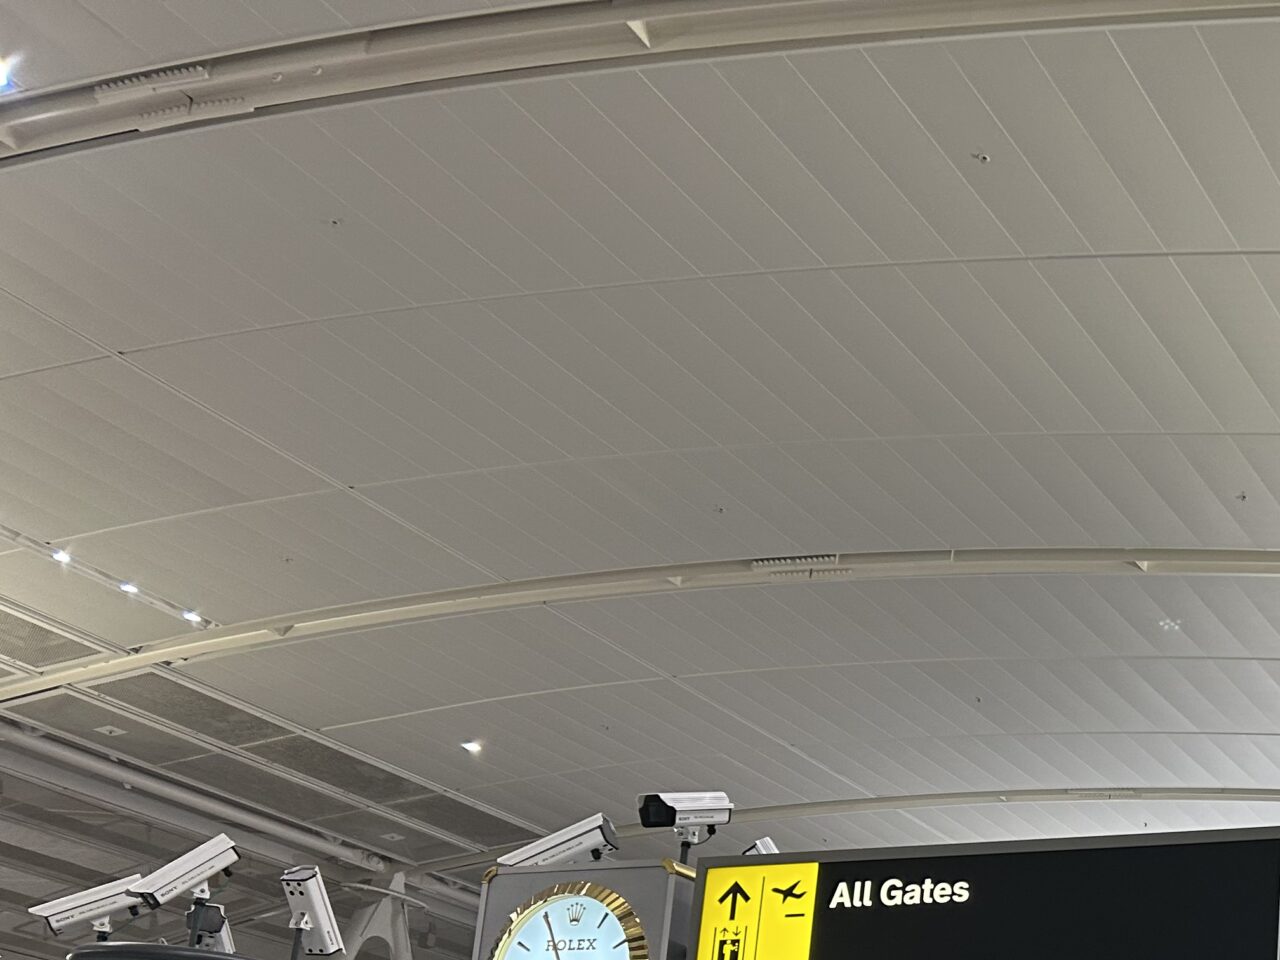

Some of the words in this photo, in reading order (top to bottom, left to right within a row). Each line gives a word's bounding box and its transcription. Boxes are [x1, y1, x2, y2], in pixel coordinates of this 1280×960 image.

[160, 885, 178, 898] SONY
[828, 880, 873, 909] All
[879, 878, 970, 906] Gates
[545, 938, 598, 952] ROLEX
